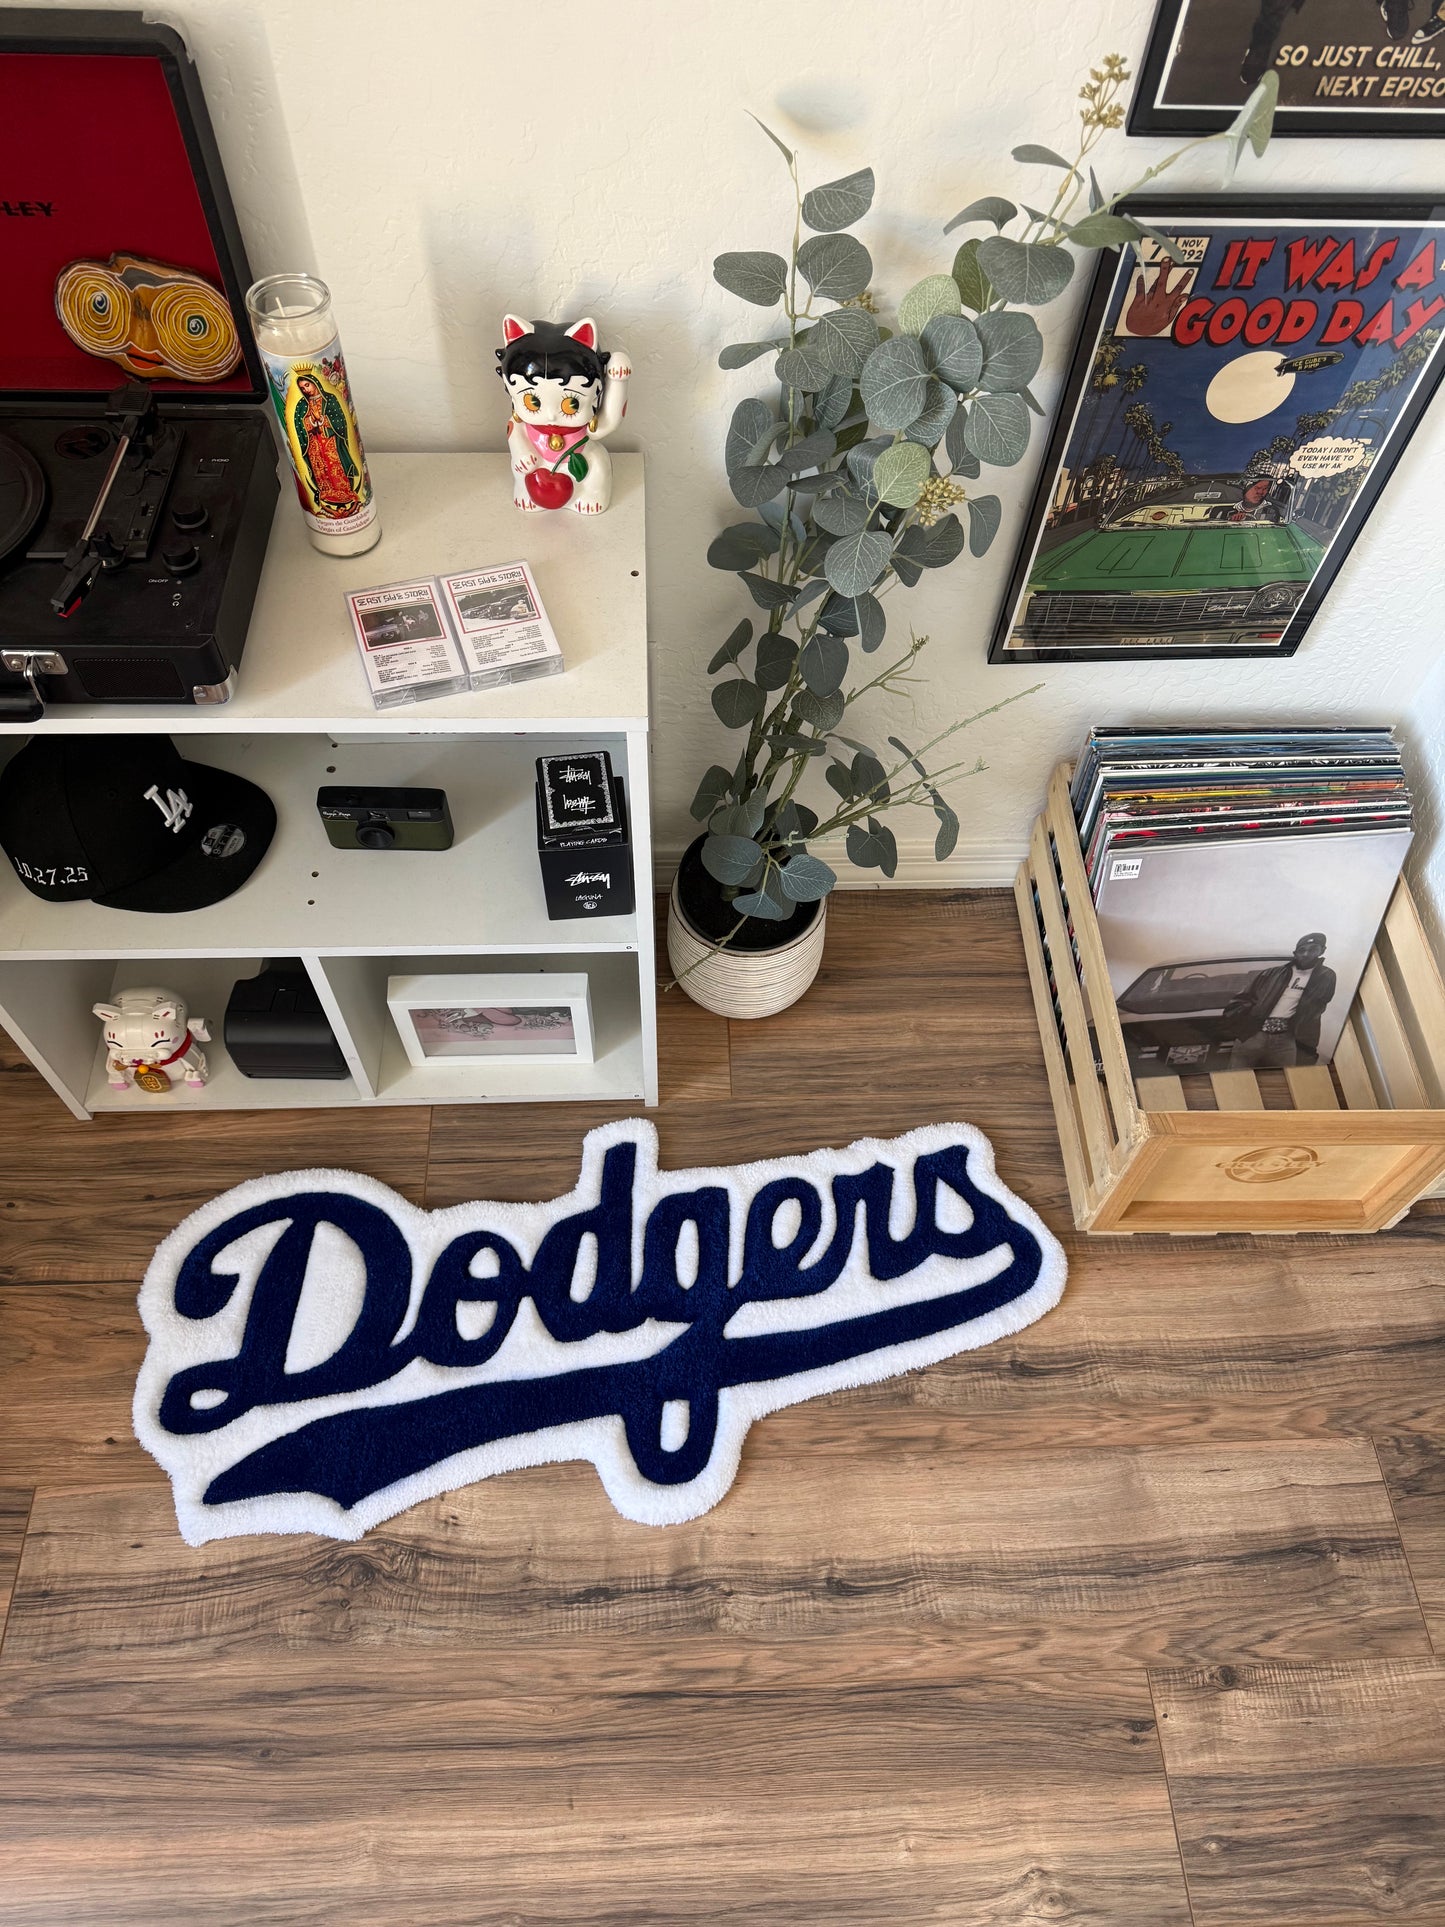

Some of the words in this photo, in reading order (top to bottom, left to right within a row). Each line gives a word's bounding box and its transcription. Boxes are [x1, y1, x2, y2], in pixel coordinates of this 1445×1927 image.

[1275, 44, 1309, 67] SO
[1312, 45, 1373, 68] JUST
[1376, 46, 1442, 71] CHILL,
[1315, 75, 1379, 97] NEXT
[1181, 239, 1204, 248] NOV.
[1214, 236, 1277, 289] IT
[1286, 235, 1400, 291] WAS
[1393, 237, 1437, 291] A
[1172, 296, 1319, 348] GOOD
[1318, 294, 1445, 350] DAY
[143, 784, 194, 834] LA
[14, 856, 89, 886] 10.27.25
[160, 1141, 1043, 1510] Dodgers
